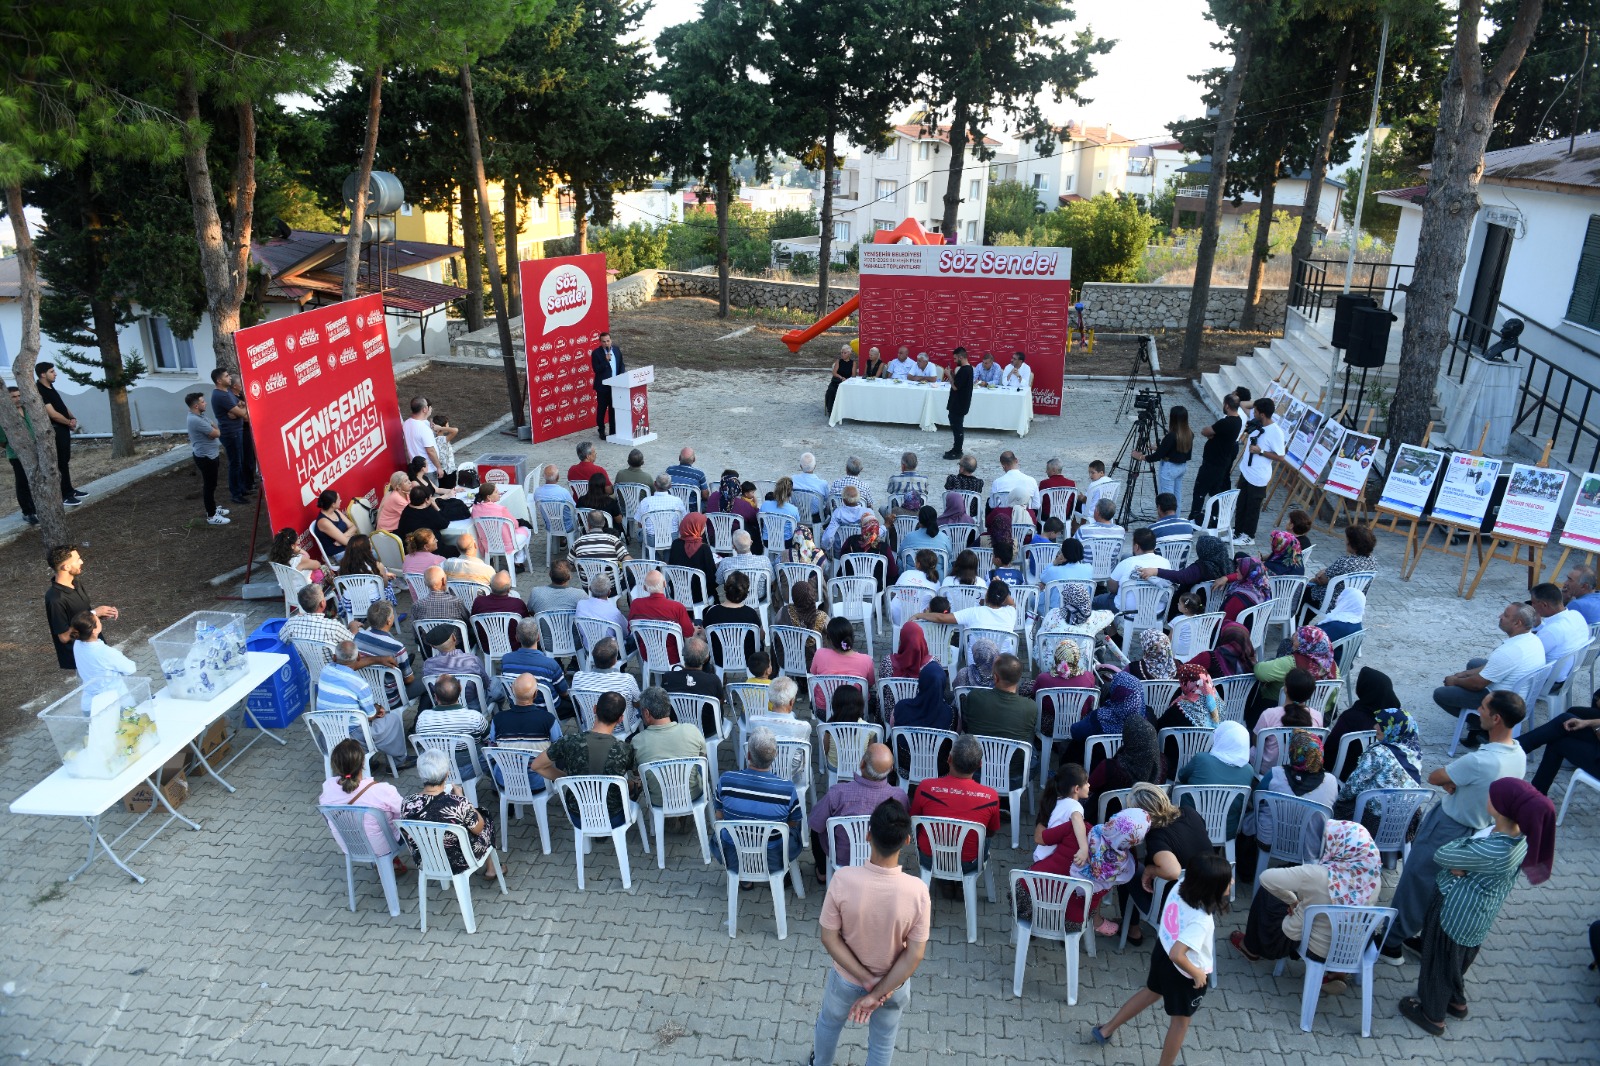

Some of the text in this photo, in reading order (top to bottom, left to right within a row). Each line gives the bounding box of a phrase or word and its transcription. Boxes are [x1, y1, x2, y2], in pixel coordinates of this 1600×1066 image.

[939, 249, 1058, 275] Söz Sende!
[548, 286, 586, 315] Sende!
[556, 273, 577, 294] Söz
[288, 378, 375, 458] YENİŞEHİR
[296, 405, 378, 484] HALK MASASI
[321, 436, 372, 485] 444 33 54
